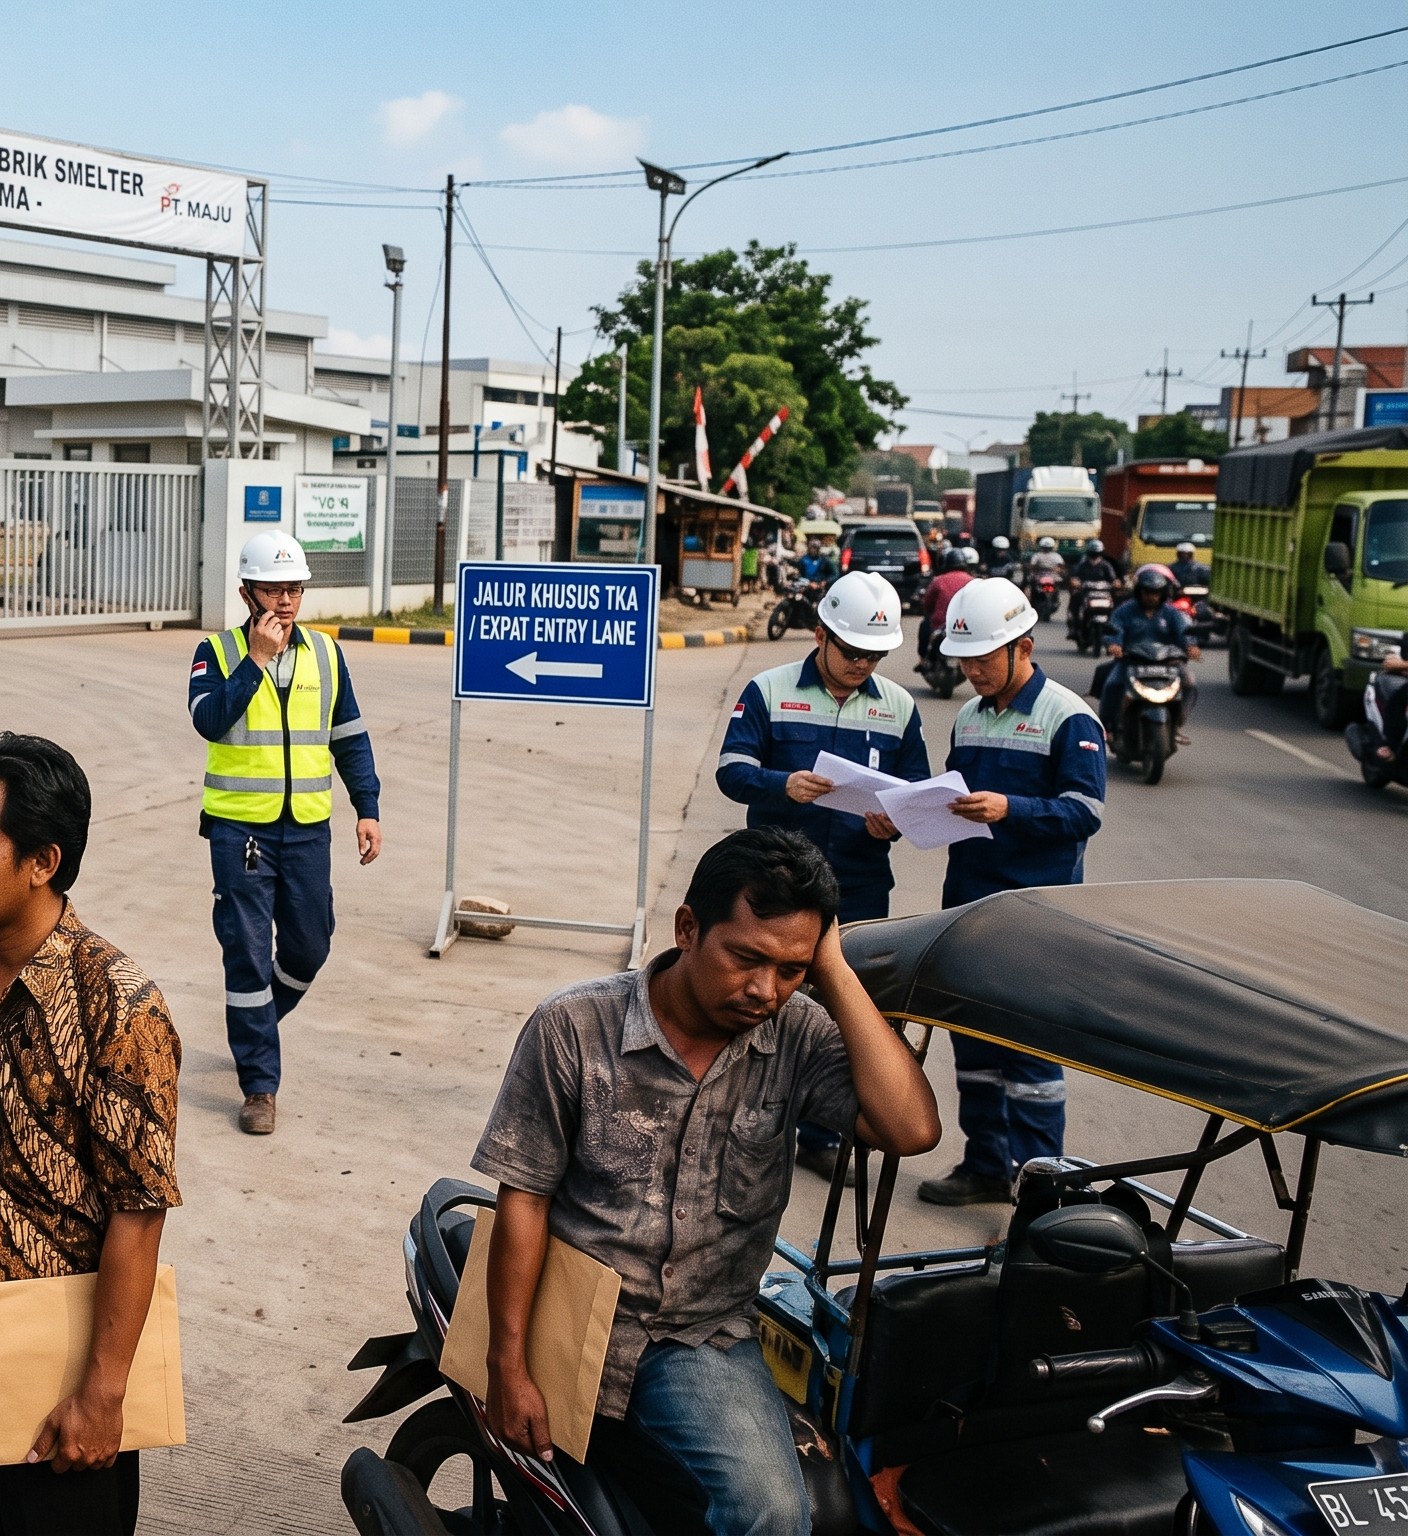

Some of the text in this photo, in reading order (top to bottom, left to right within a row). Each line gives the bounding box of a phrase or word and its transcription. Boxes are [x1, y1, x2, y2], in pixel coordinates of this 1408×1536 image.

[55, 158, 144, 197] SMELTER
[160, 196, 232, 223] PT. MAJU
[473, 581, 638, 611] JALUR KHUSUS TKA
[480, 615, 529, 641] EXPAT
[534, 617, 588, 644] ENTRY
[592, 619, 636, 646] LANE
[1319, 1485, 1408, 1528] BL 45
